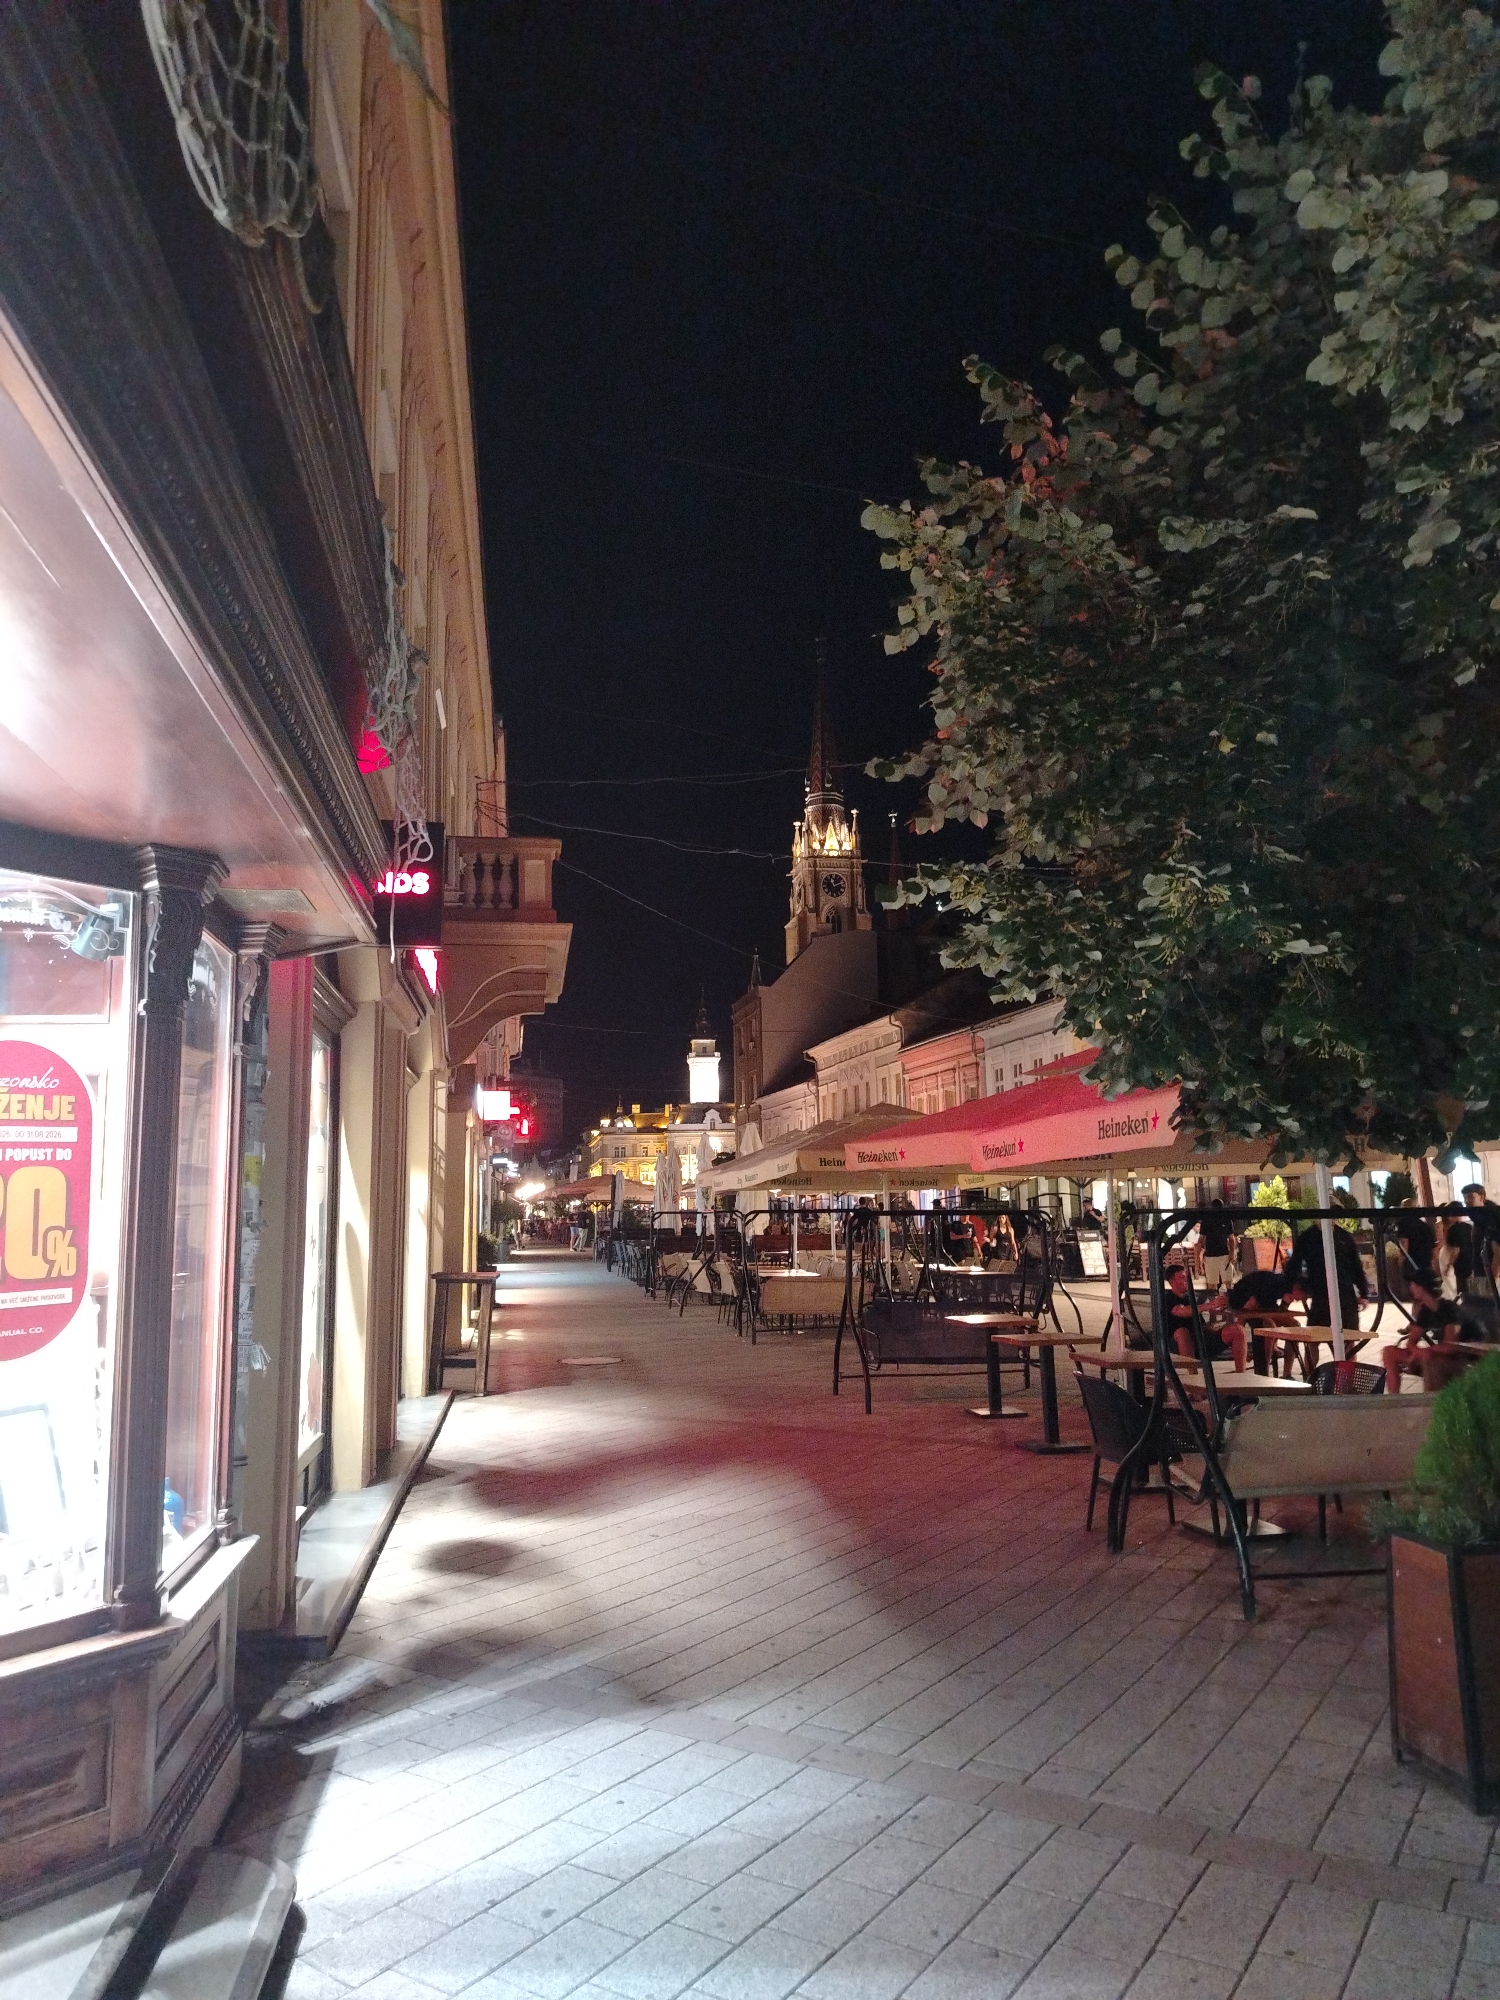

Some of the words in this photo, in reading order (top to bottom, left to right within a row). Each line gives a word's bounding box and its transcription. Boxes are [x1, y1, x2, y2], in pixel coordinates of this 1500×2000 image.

[0, 1066, 60, 1089] zonsko
[1097, 1114, 1149, 1140] Heineken
[5, 1148, 54, 1161] POPUST
[55, 1147, 72, 1161] DO
[857, 1150, 898, 1164] Heineken
[981, 1140, 1017, 1161] Heineken
[0, 1166, 77, 1280] 0%
[28, 1326, 44, 1334] CO.
